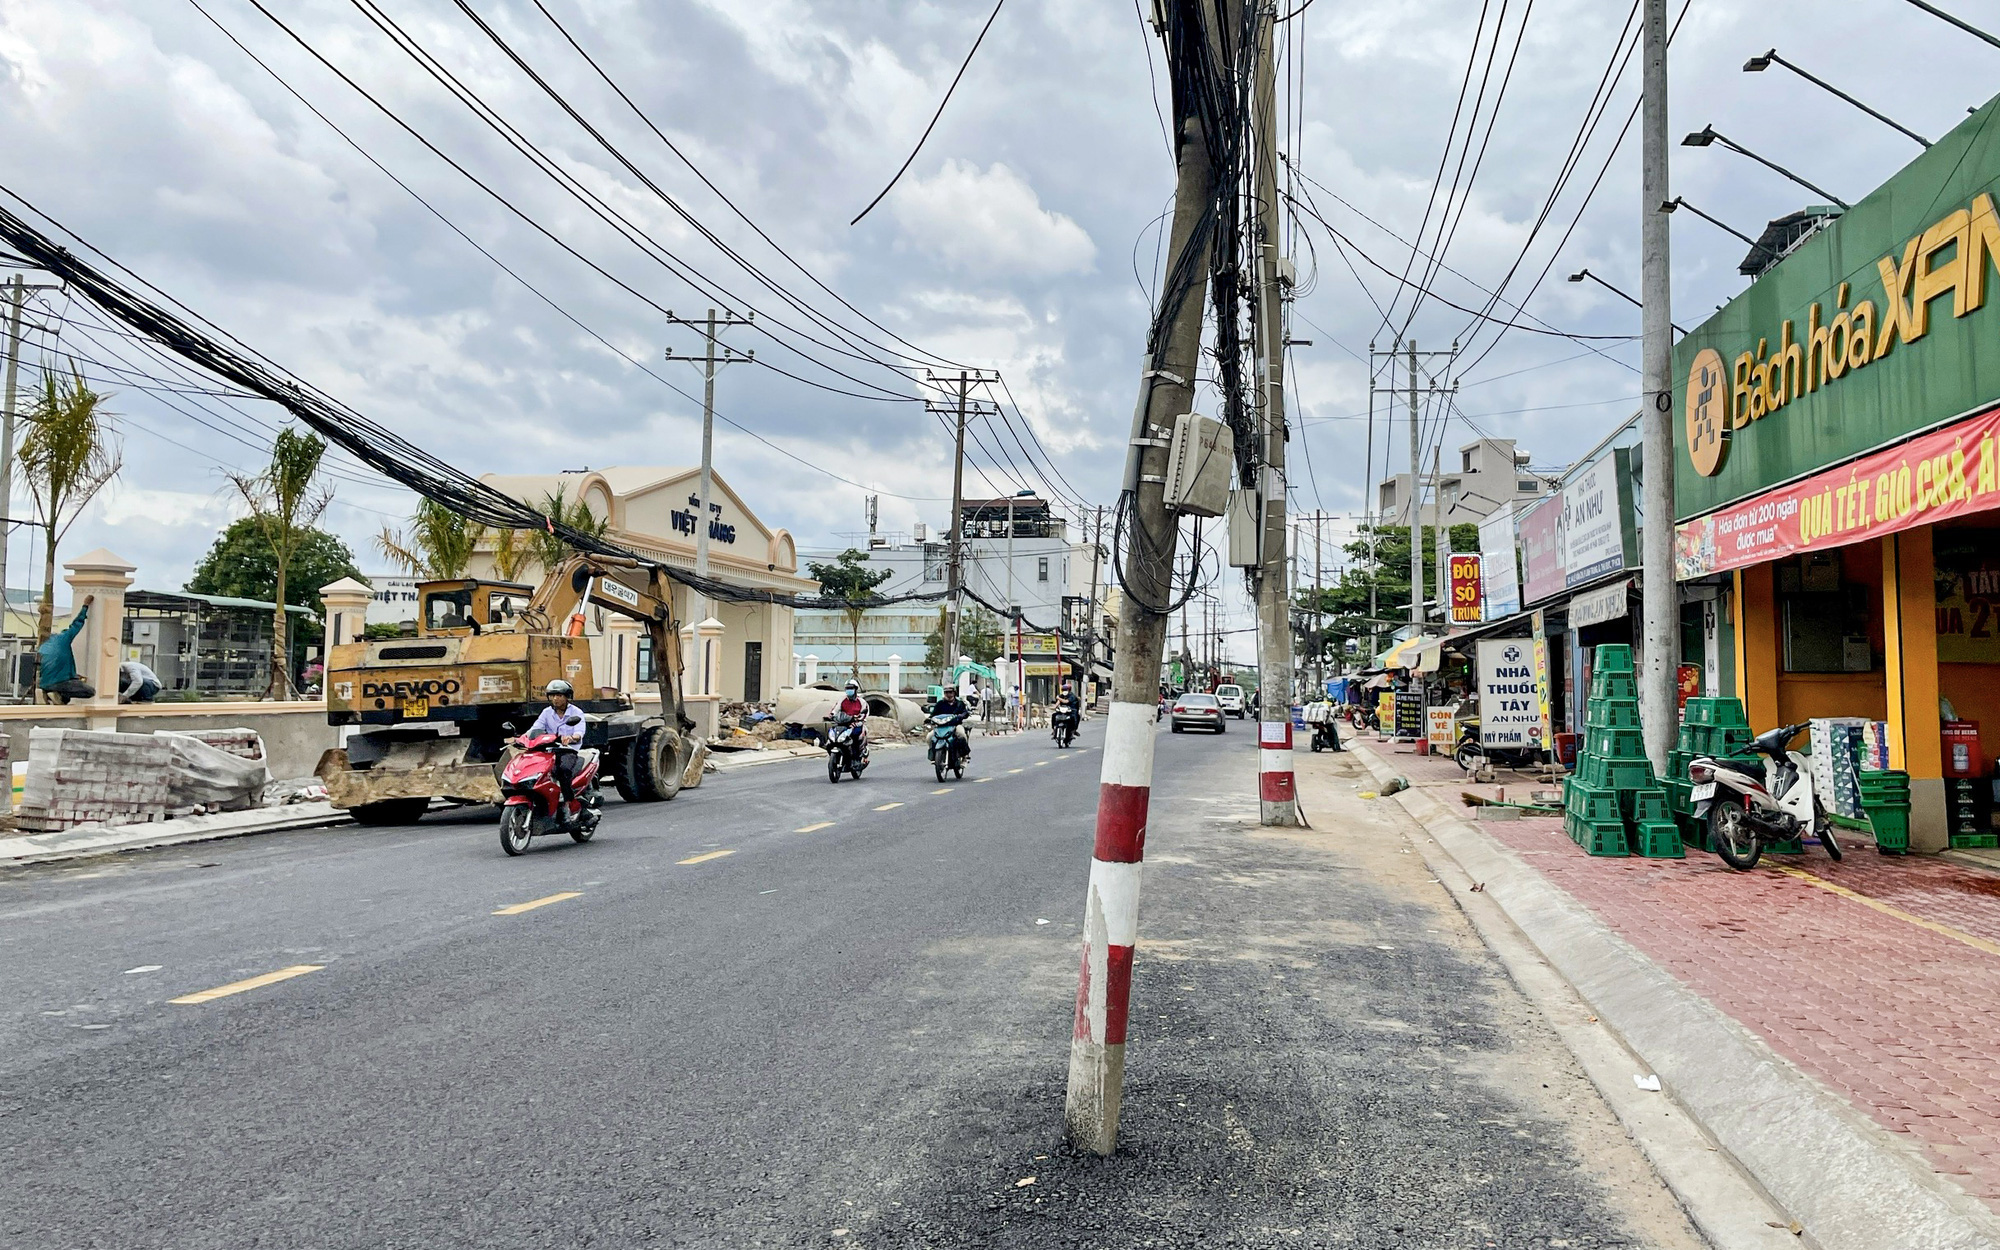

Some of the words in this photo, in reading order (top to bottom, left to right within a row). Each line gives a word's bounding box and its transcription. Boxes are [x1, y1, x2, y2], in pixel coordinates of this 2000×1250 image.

[1733, 320, 1803, 431] Bách
[1807, 281, 1875, 393] hóa
[1800, 485, 1833, 546] QUÀ
[1836, 467, 1871, 530] TẾT,
[1874, 460, 1912, 523] GIÒ
[1916, 436, 1972, 512] CHẢ,
[1977, 430, 2000, 495] Ă
[1575, 502, 1585, 528] AN
[1586, 490, 1604, 521] NHƯ
[1718, 517, 1733, 535] Hóa
[1733, 513, 1748, 531] đơn
[1749, 507, 1758, 527] từ
[1758, 502, 1775, 522] 200
[1776, 496, 1798, 520] ngàn
[671, 508, 697, 537] VIỆT
[1736, 530, 1755, 553] được
[1453, 557, 1479, 579] ĐỔI
[373, 589, 398, 604] VIỆT
[1455, 580, 1476, 602] SỐ
[1453, 602, 1481, 620] TRÚNG
[1969, 596, 1991, 638] 2
[1496, 665, 1531, 677] NHÀ
[363, 680, 460, 699] DAEWOO
[1487, 681, 1538, 694] THUỐC
[1500, 699, 1530, 711] TÂY
[1484, 731, 1496, 743] MỸ
